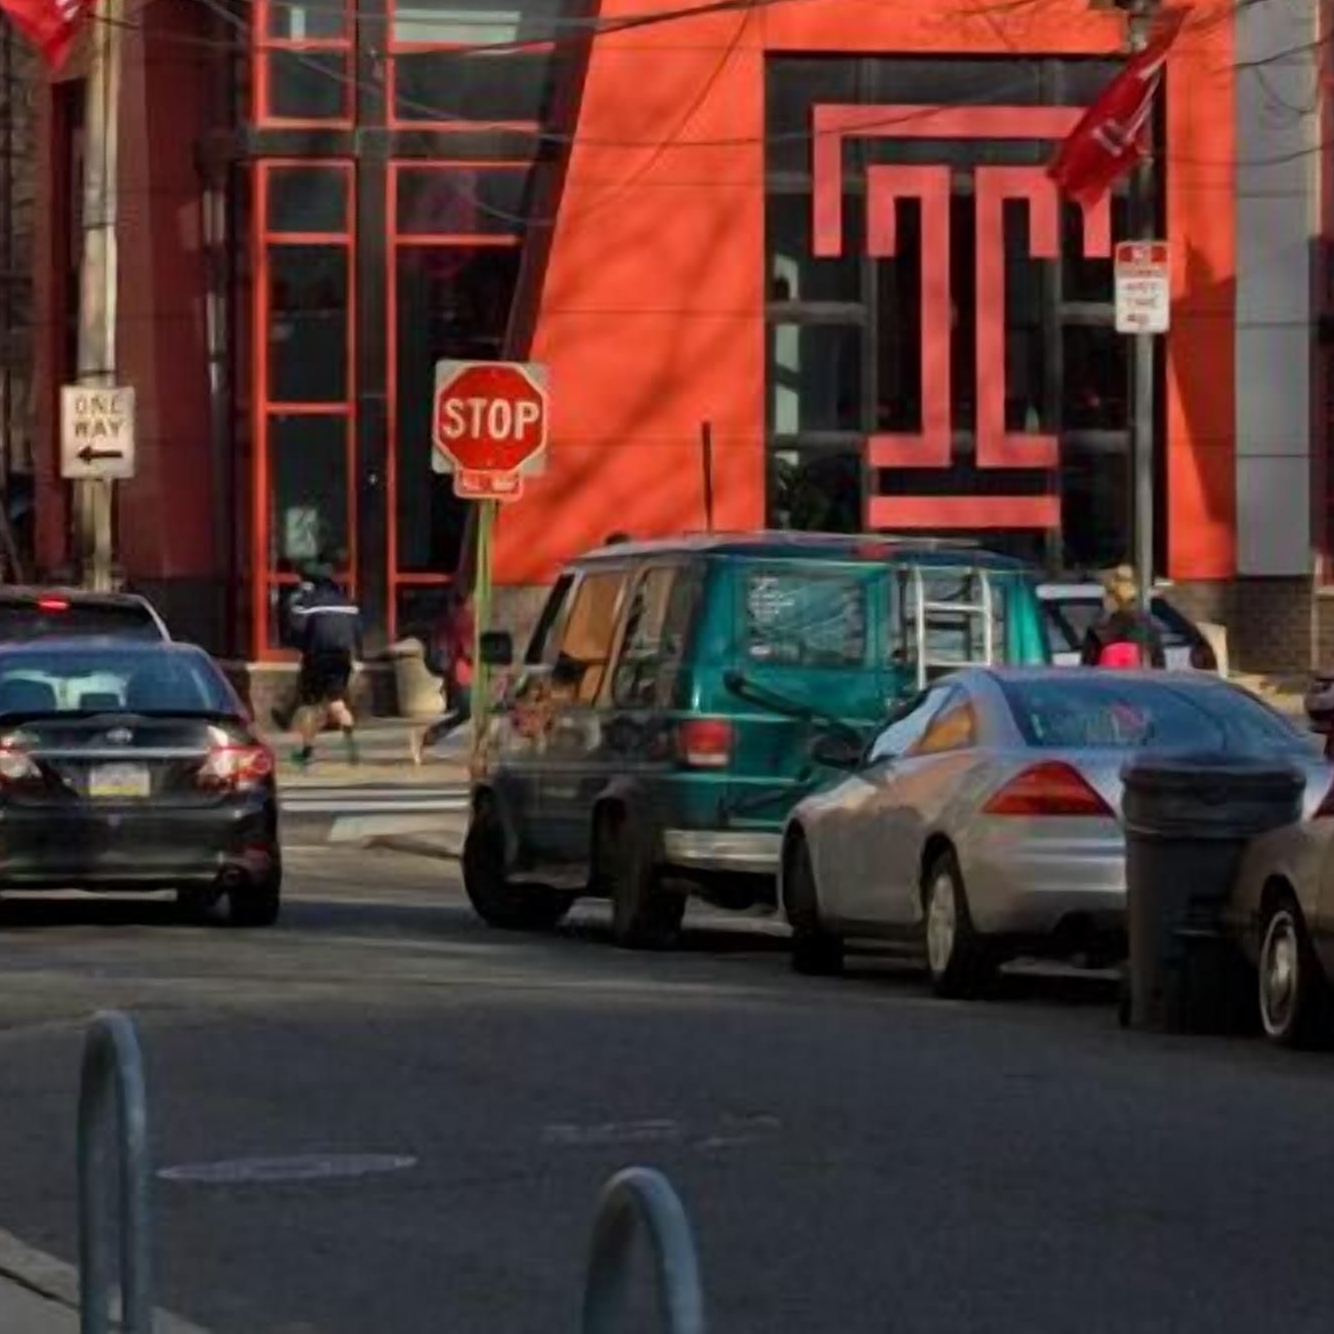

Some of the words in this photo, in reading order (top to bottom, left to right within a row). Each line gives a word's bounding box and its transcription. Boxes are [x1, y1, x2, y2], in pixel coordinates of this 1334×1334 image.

[75, 395, 123, 414] ONE
[74, 419, 127, 438] WAY
[442, 398, 540, 440] STOP
